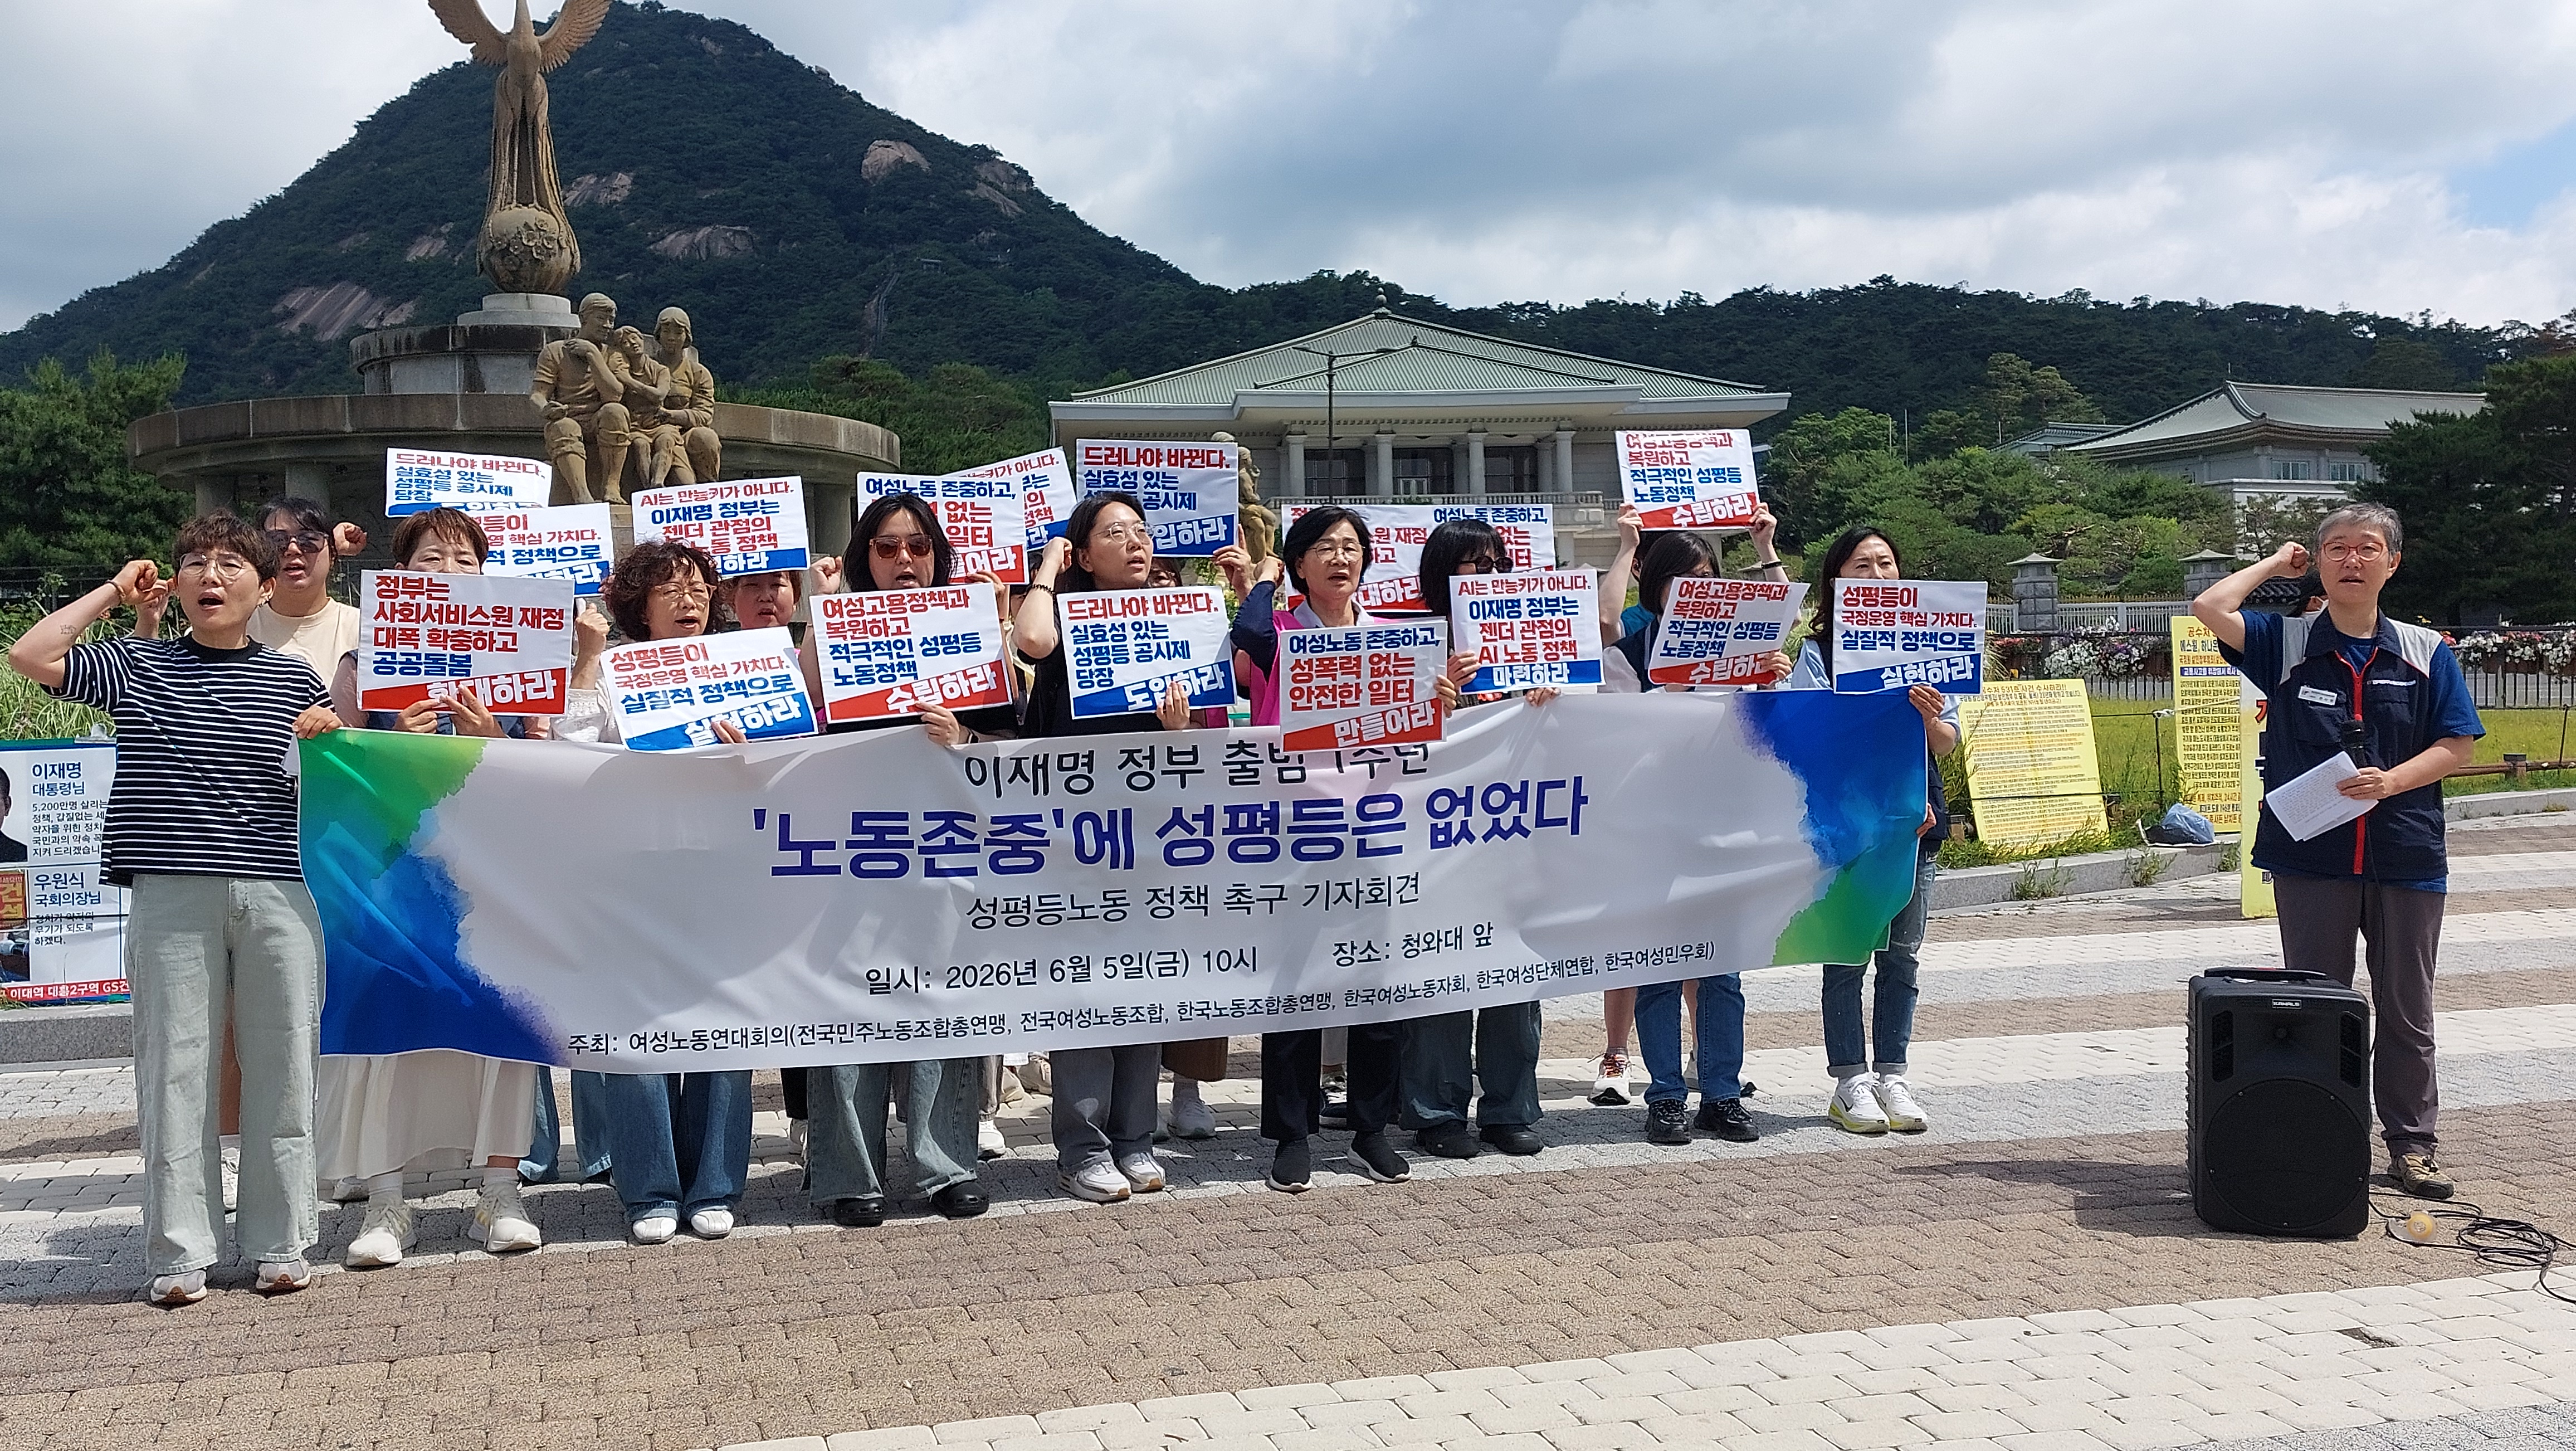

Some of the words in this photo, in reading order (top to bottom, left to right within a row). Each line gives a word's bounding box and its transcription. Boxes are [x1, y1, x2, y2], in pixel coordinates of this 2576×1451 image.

[396, 453, 476, 469] 드러나야
[482, 460, 545, 479] 바뀐다.
[1015, 454, 1059, 473] 아니다.
[1084, 447, 1162, 468] 드러나야
[1168, 449, 1230, 469] 바뀐다.
[1628, 451, 1691, 467] 복원하고
[395, 466, 451, 479] 실효성
[457, 470, 494, 484] 있는
[1084, 470, 1138, 489] 실효성
[1143, 471, 1179, 490] 있는
[1631, 468, 1692, 485] 적극적인
[1697, 468, 1742, 484] 성평등
[395, 478, 451, 491] 성평등
[457, 483, 513, 496] 공시제
[395, 490, 432, 501] 당장
[640, 494, 674, 507] AI는
[678, 485, 739, 503] 만능키가
[743, 481, 794, 496] 아니다.
[941, 481, 1016, 499] 존중하고,
[1634, 486, 1696, 502] 노동정책
[651, 504, 712, 524] 이재명
[719, 500, 779, 518] 정부는
[945, 501, 992, 523] 없는
[1143, 492, 1197, 510] 공시제
[1672, 493, 1752, 528] 수립하라
[1491, 508, 1548, 524] 존중하고,
[509, 534, 543, 545] 핵심
[547, 529, 601, 543] 가치다.
[663, 523, 704, 541] 젠더
[710, 517, 771, 537] 관점의
[945, 526, 993, 547] 일터
[1153, 518, 1227, 549] 입하라
[1395, 528, 1427, 544] 재정
[1496, 526, 1530, 545] 없는
[737, 534, 778, 552] 정책
[513, 545, 601, 565] 정책으로
[375, 576, 450, 601] 정부는
[1458, 581, 1488, 596] AI는
[1491, 578, 1545, 595] 만능키가
[1548, 575, 1591, 591] 아니다.
[1678, 580, 1789, 601] 여성고용정책과
[823, 589, 970, 619] 여성고용정책과
[1067, 596, 1148, 621] 드러나야
[1153, 593, 1218, 615] 바뀐다.
[1469, 598, 1522, 620] 이재명
[1526, 596, 1579, 617] 정부는
[1843, 586, 1918, 608] 성평등이
[373, 602, 513, 628] 사회서비스원
[519, 607, 564, 630] 재정
[1674, 600, 1737, 620] 복원하고
[1841, 611, 1895, 626] 국정운영
[1900, 611, 1928, 627] 핵심
[1931, 612, 1977, 628] 가치다.
[826, 617, 911, 640] 복원하고
[1070, 623, 1127, 645] 실효성
[1131, 621, 1169, 641] 있는
[1479, 621, 1514, 642] 젠더
[1520, 619, 1572, 640] 관점의
[1667, 620, 1731, 639] 적극적인
[1733, 622, 1782, 640] 성평등
[373, 627, 420, 650] 대폭
[426, 628, 518, 653] 확충하고
[829, 639, 914, 663] 적극적인
[919, 632, 982, 656] 성평등
[1289, 632, 1362, 654] 여성노동
[1366, 627, 1440, 650] 존중하고,
[1660, 640, 1726, 659] 노동정책
[1841, 630, 1895, 651] 실질적
[1900, 631, 1976, 652] 정책으로
[610, 642, 709, 673] 성평등이
[1074, 644, 1130, 666] 성평등
[1134, 640, 1191, 663] 공시제
[1479, 645, 1499, 664] AI
[1504, 643, 1538, 663] 노동
[1542, 640, 1578, 661] 정책
[373, 651, 472, 676] 공공돌봄
[616, 668, 688, 689] 국정운영
[692, 665, 728, 680] 핵심
[733, 656, 790, 675] 가치다.
[833, 661, 918, 686] 노동정책
[1290, 655, 1362, 684] 성폭력
[1368, 653, 1416, 679] 없는
[1492, 663, 1569, 686] 마련하라
[1880, 655, 1974, 688] 실현하라
[886, 664, 996, 714] 수립하라
[1076, 668, 1114, 689] 당장
[1124, 664, 1225, 710] 도입하라
[621, 688, 695, 714] 실질적
[699, 675, 796, 703] 정책으로
[1289, 682, 1363, 712] 안전한
[1368, 679, 1414, 706] 일터
[1334, 701, 1436, 748] 만들어라
[32, 762, 81, 780] 이재명
[965, 748, 1095, 798] 이재명
[1117, 744, 1206, 792] 정부
[1222, 739, 1306, 786] 출범
[32, 781, 85, 796] 대통령님
[81, 800, 108, 809] 살리는
[32, 814, 53, 823] 정책,
[56, 811, 93, 821] 갑질없는
[32, 825, 60, 834] 약자를
[64, 824, 81, 832] 위한
[84, 822, 103, 832] 정치
[753, 805, 1135, 880] '노동존중'에
[1155, 791, 1407, 870] 성평등은
[1425, 775, 1589, 850] 없었다
[32, 835, 69, 845] 국민과의
[72, 835, 90, 844] 약속
[33, 848, 51, 857] 지켜
[54, 845, 100, 856] 드리겠습니
[35, 872, 84, 890] 우원식
[35, 891, 101, 907] 국회의장님
[967, 887, 1129, 931] 성평등노동
[1144, 883, 1209, 920] 정책
[1224, 879, 1288, 917] 촉구
[1301, 870, 1420, 912] 기자회견
[35, 924, 62, 934] 무기가
[35, 936, 66, 946] 하겠다.
[1332, 939, 1391, 968] 장소:
[1401, 928, 1463, 961] 청와대
[1473, 922, 1493, 950] 앞
[864, 965, 932, 996] 일시:
[945, 960, 1040, 991] 2026년
[1048, 954, 1092, 983] 6월
[1102, 950, 1189, 981] 5일(금)
[1202, 946, 1259, 975] 10시
[11, 988, 43, 1000] 이대역
[103, 981, 130, 991] GS건
[568, 1032, 619, 1056] 주최:
[628, 1013, 1012, 1054] 여성노동연대회의(전국민주노동조합총연맹,
[1020, 1002, 1170, 1033] 전국여성노동조합,
[1177, 992, 1336, 1022] 한국노동조합총연맹,
[1344, 973, 1471, 1009] 한국여성노동자회,
[1476, 956, 1599, 989] 한국여성단체연합,
[1605, 941, 1715, 971] 한국여성민우회)
